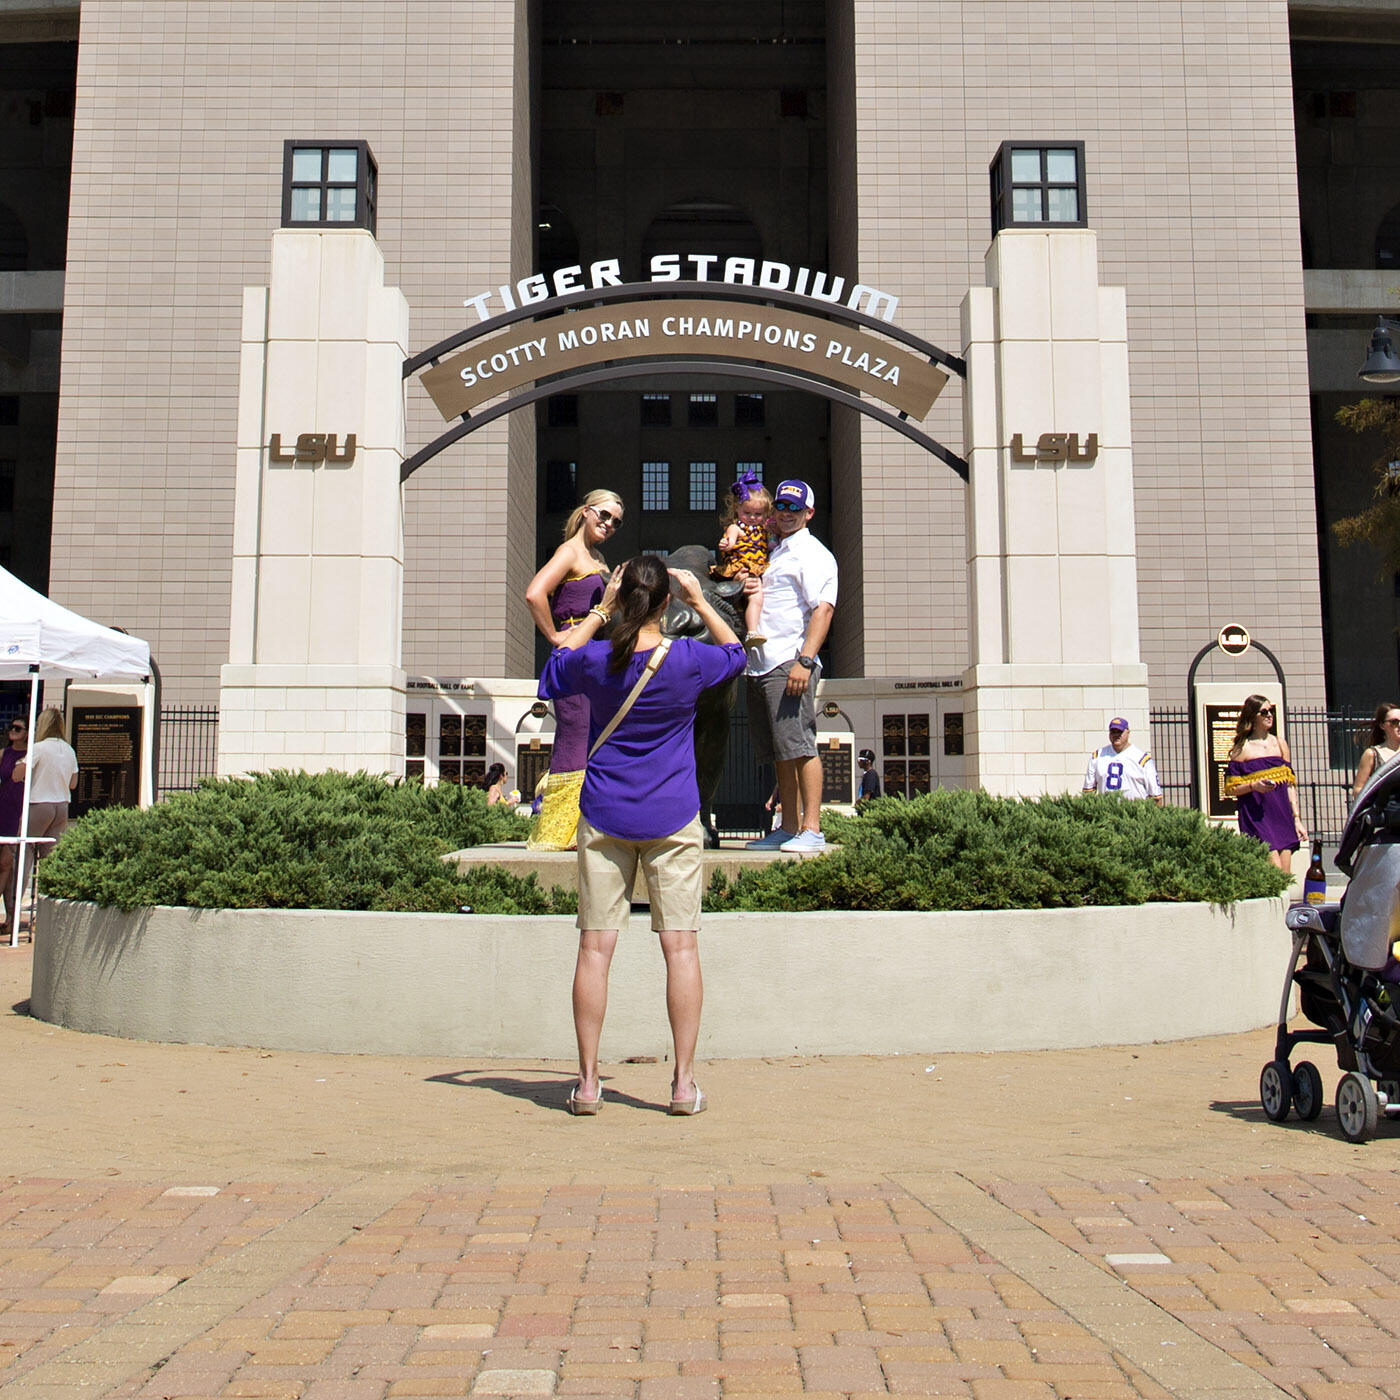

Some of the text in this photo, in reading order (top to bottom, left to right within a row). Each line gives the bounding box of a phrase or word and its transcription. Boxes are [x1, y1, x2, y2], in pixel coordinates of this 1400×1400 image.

[463, 253, 900, 323] TIGER STADIUM
[459, 315, 903, 389] SCOTTY MORAN CHAMPIONS PLAZA
[269, 433, 357, 462] LSU
[1011, 433, 1098, 462] LSU
[1221, 634, 1248, 646] LSU
[1106, 761, 1124, 790] 8
